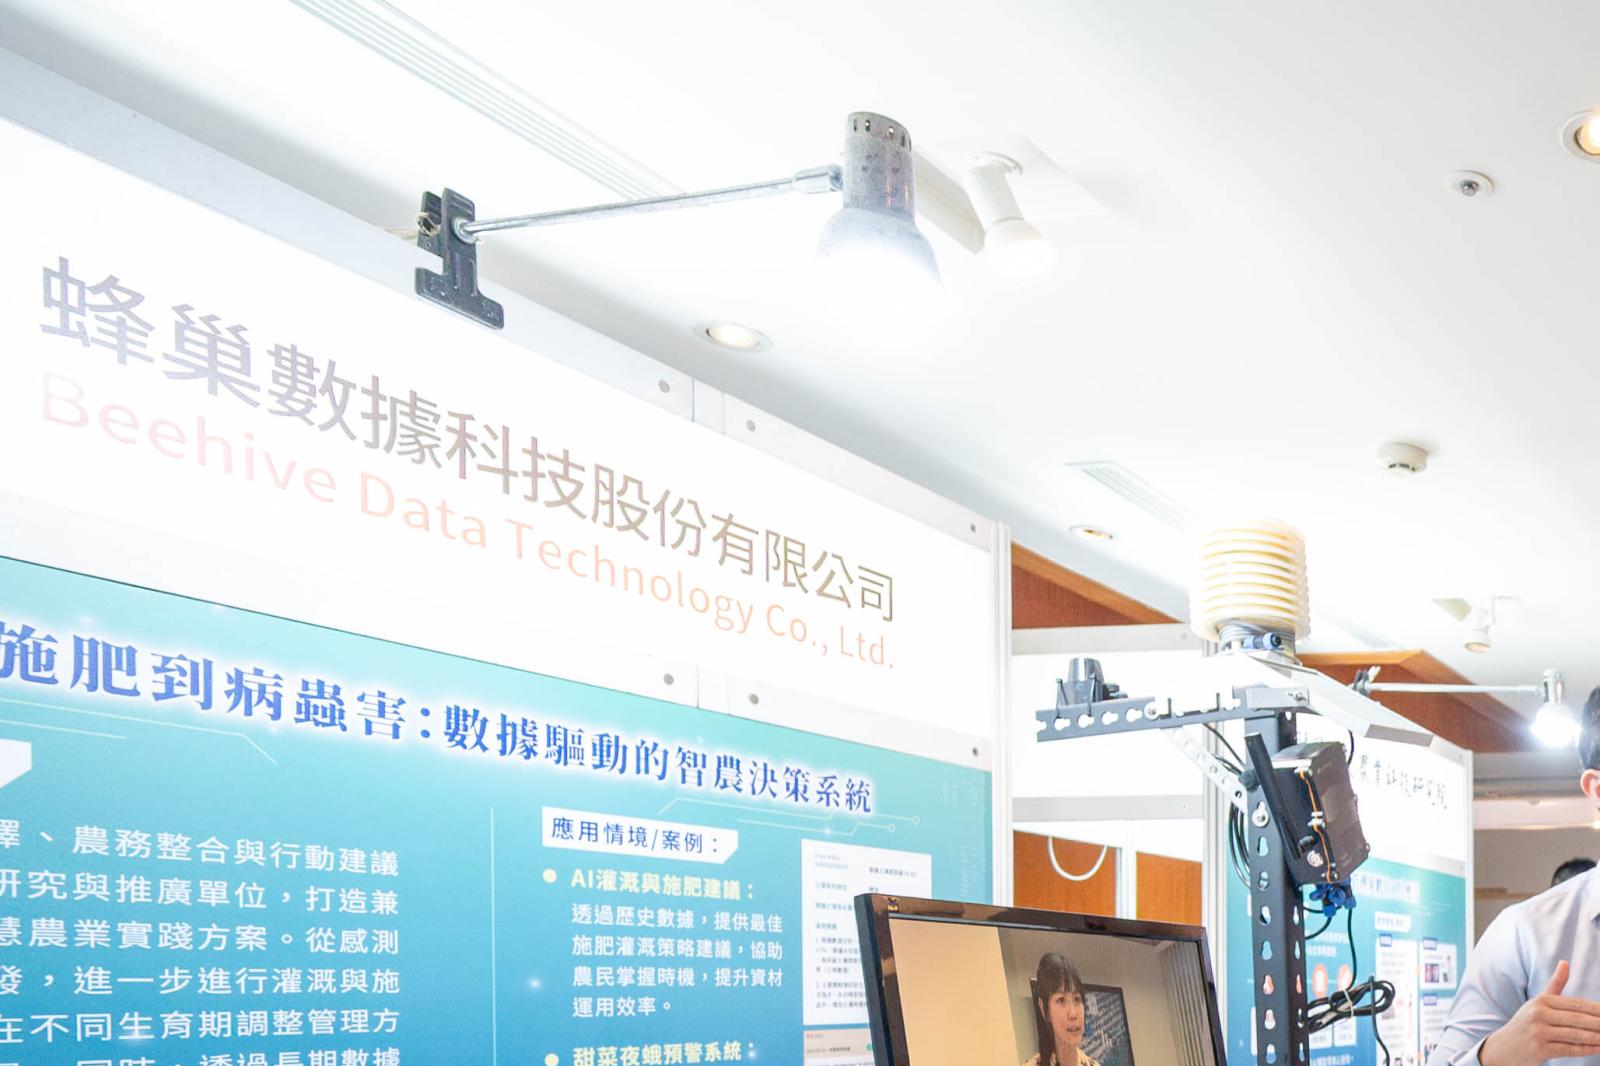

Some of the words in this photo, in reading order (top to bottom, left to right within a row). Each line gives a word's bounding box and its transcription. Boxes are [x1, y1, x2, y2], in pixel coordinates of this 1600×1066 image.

[40, 256, 893, 622] 蜂巢數據科技股份有限公司
[42, 371, 337, 503] Beehive
[360, 471, 488, 549] Data
[505, 517, 754, 634] Technology
[766, 604, 829, 657] Co.,
[839, 625, 895, 669] Ltd.
[551, 817, 718, 855] 應用情境/案例：
[570, 868, 753, 901] AI灌溉與施肥建議：
[571, 902, 784, 934] 透過歷史數據，提供最佳
[572, 934, 783, 961] 施肥灌溉策略建議，協助
[572, 965, 783, 988] 農民掌握時機，提升資材
[572, 996, 671, 1019] 運用效率。
